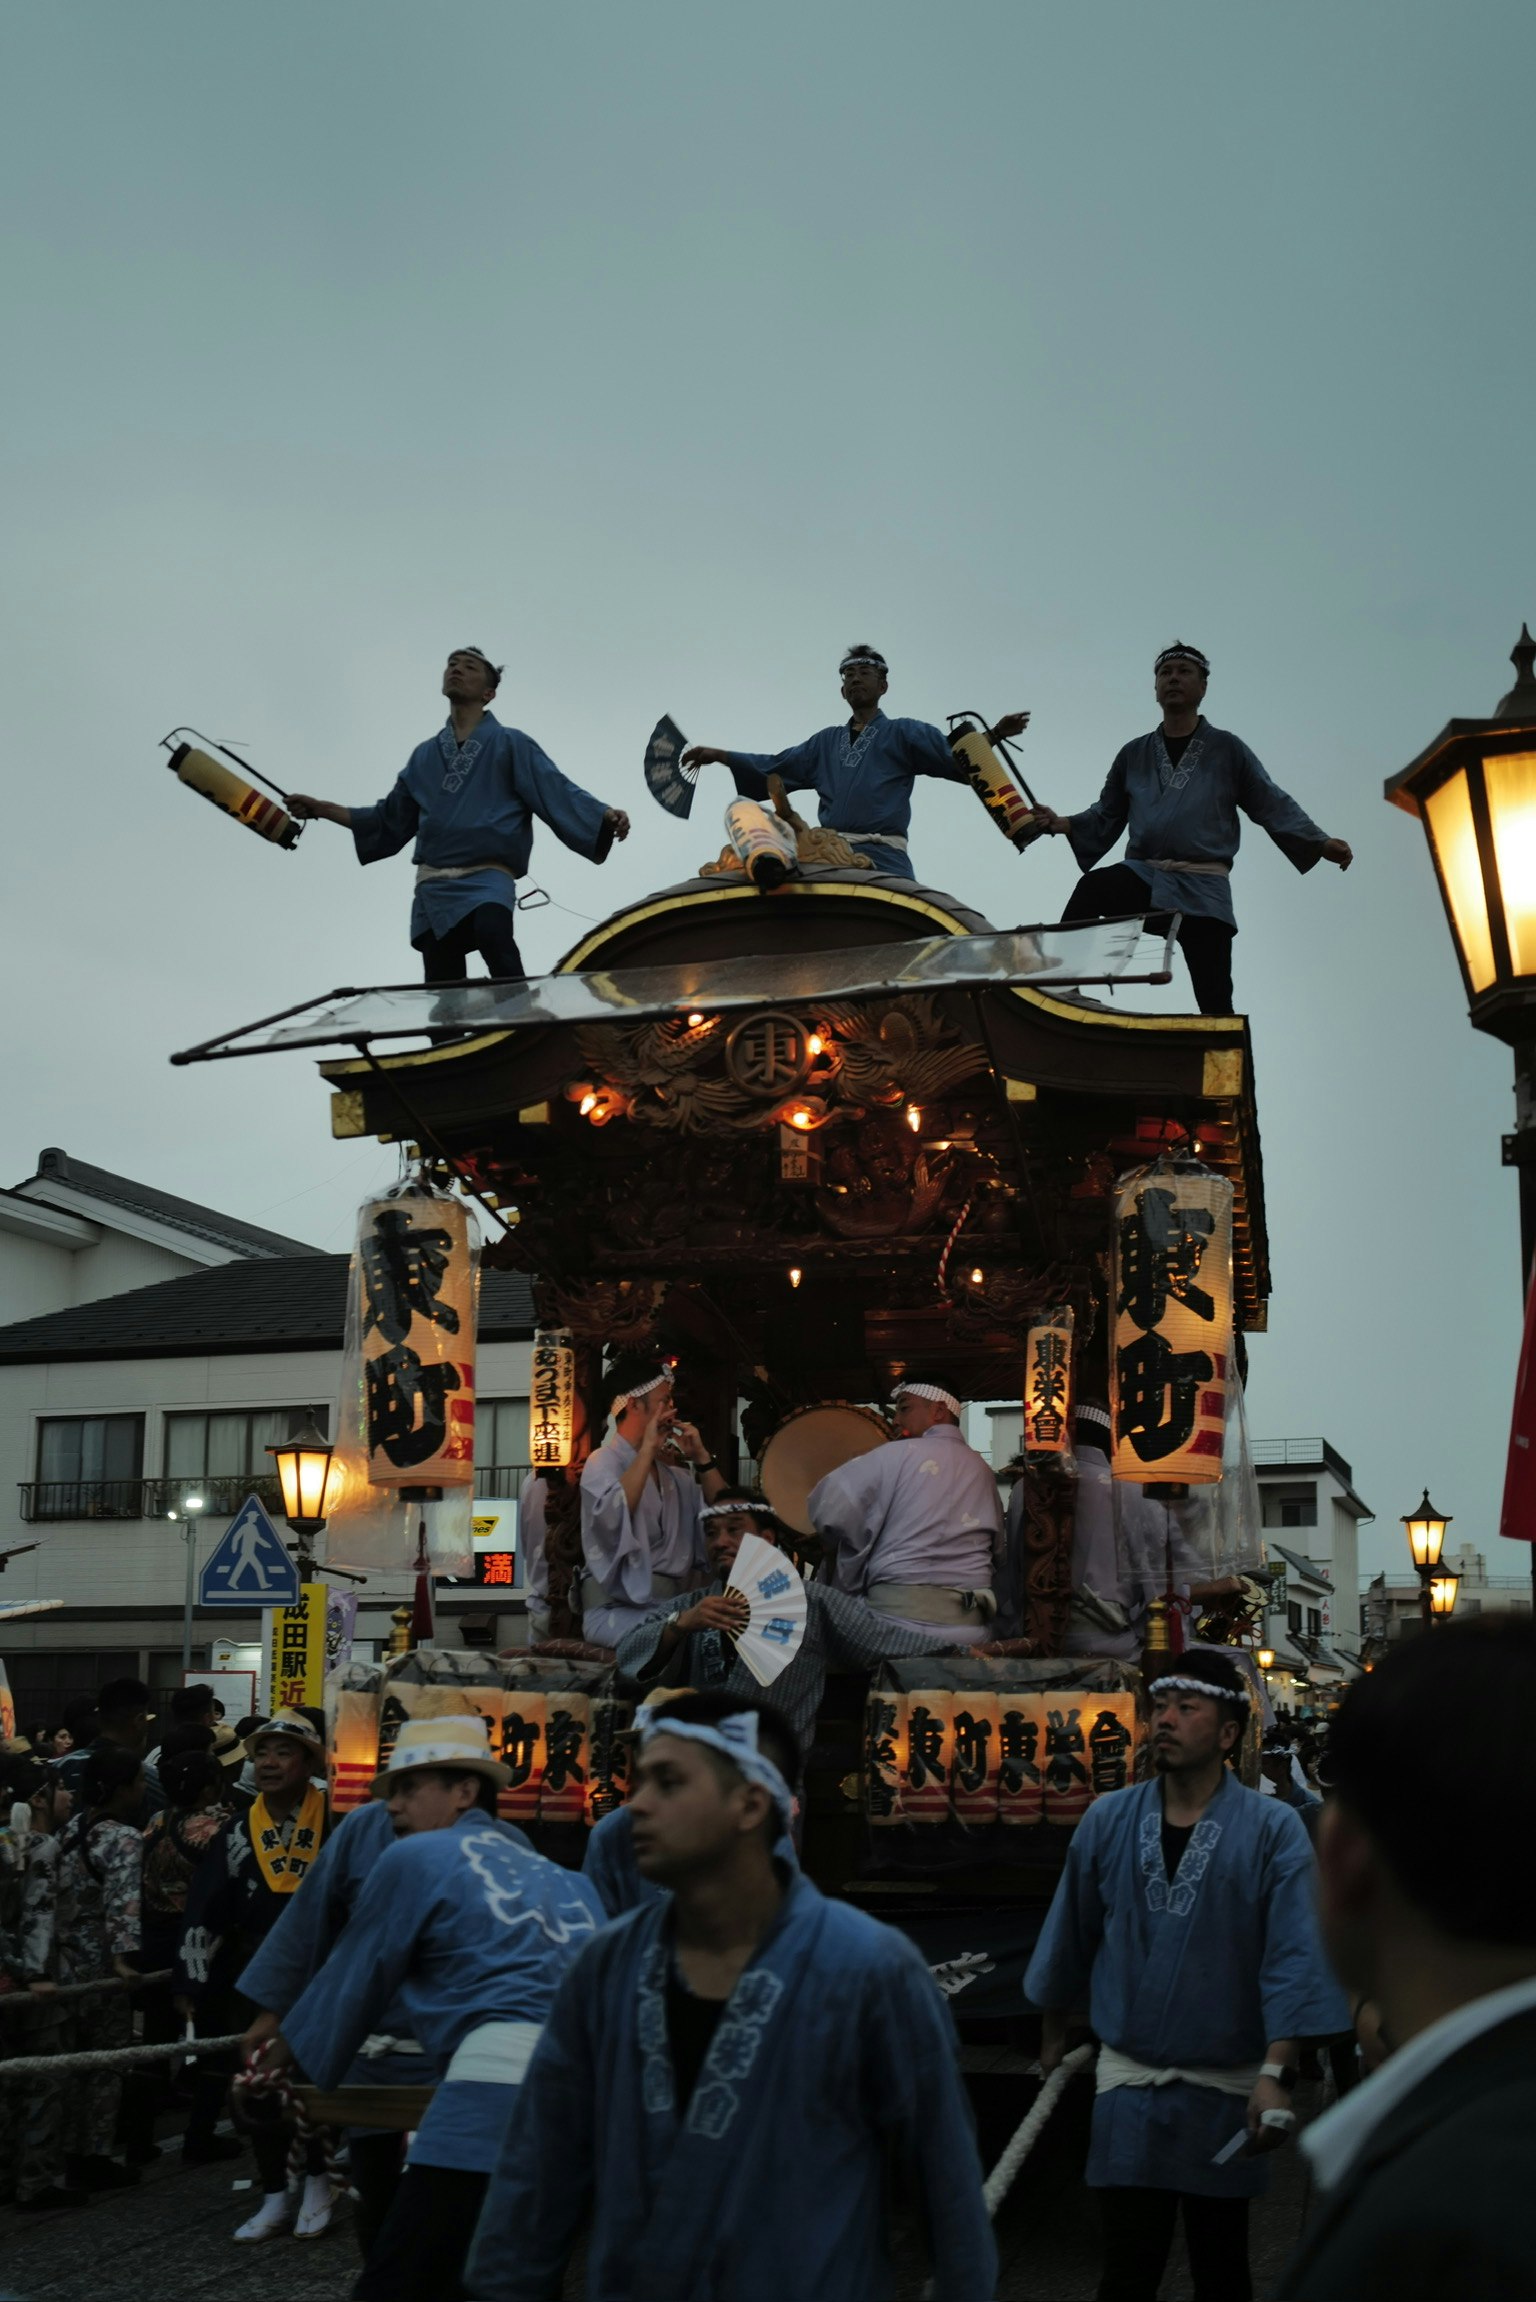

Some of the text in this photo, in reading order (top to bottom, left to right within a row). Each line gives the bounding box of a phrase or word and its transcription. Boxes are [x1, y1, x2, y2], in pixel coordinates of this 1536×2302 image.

[743, 1021, 799, 1087] 東
[360, 1209, 462, 1468] 東町
[1115, 1187, 1214, 1463] 東町
[482, 1552, 513, 1585] 満
